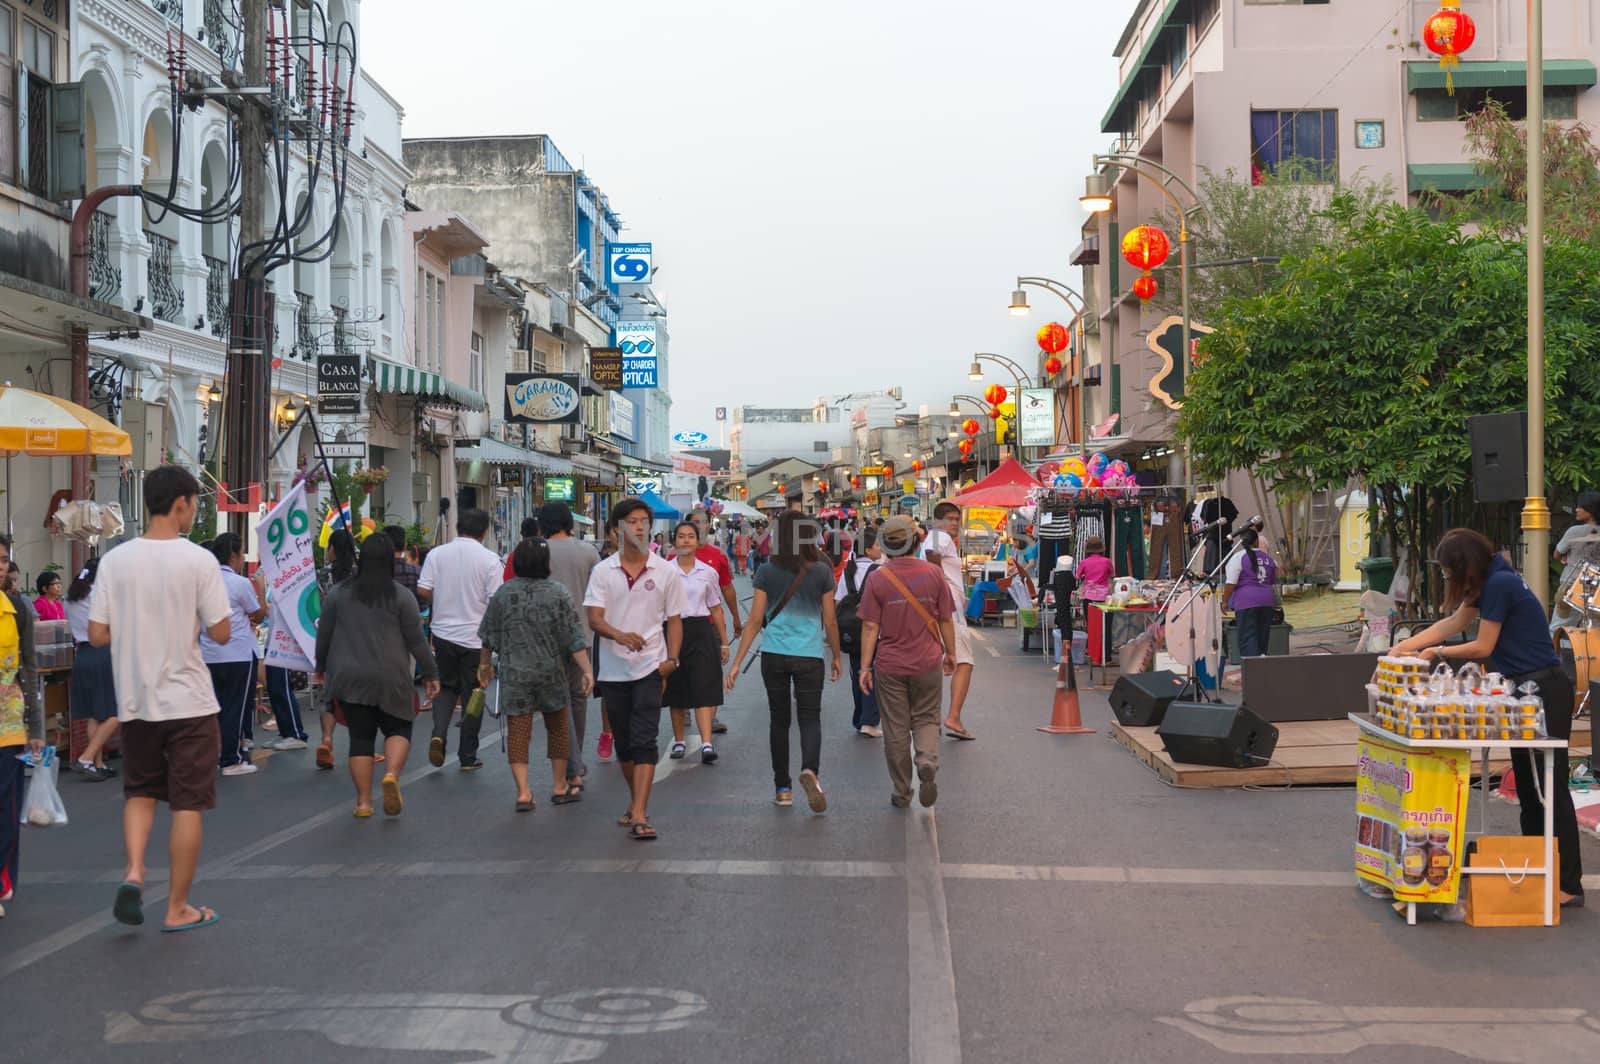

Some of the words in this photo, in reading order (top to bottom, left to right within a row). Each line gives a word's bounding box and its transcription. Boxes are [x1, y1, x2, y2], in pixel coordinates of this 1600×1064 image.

[321, 362, 357, 377] CASA
[594, 371, 620, 380] OPTIC
[623, 371, 656, 385] PTICAL
[319, 380, 359, 391] BLANCA
[679, 431, 703, 442] Ford
[266, 498, 309, 556] 96
